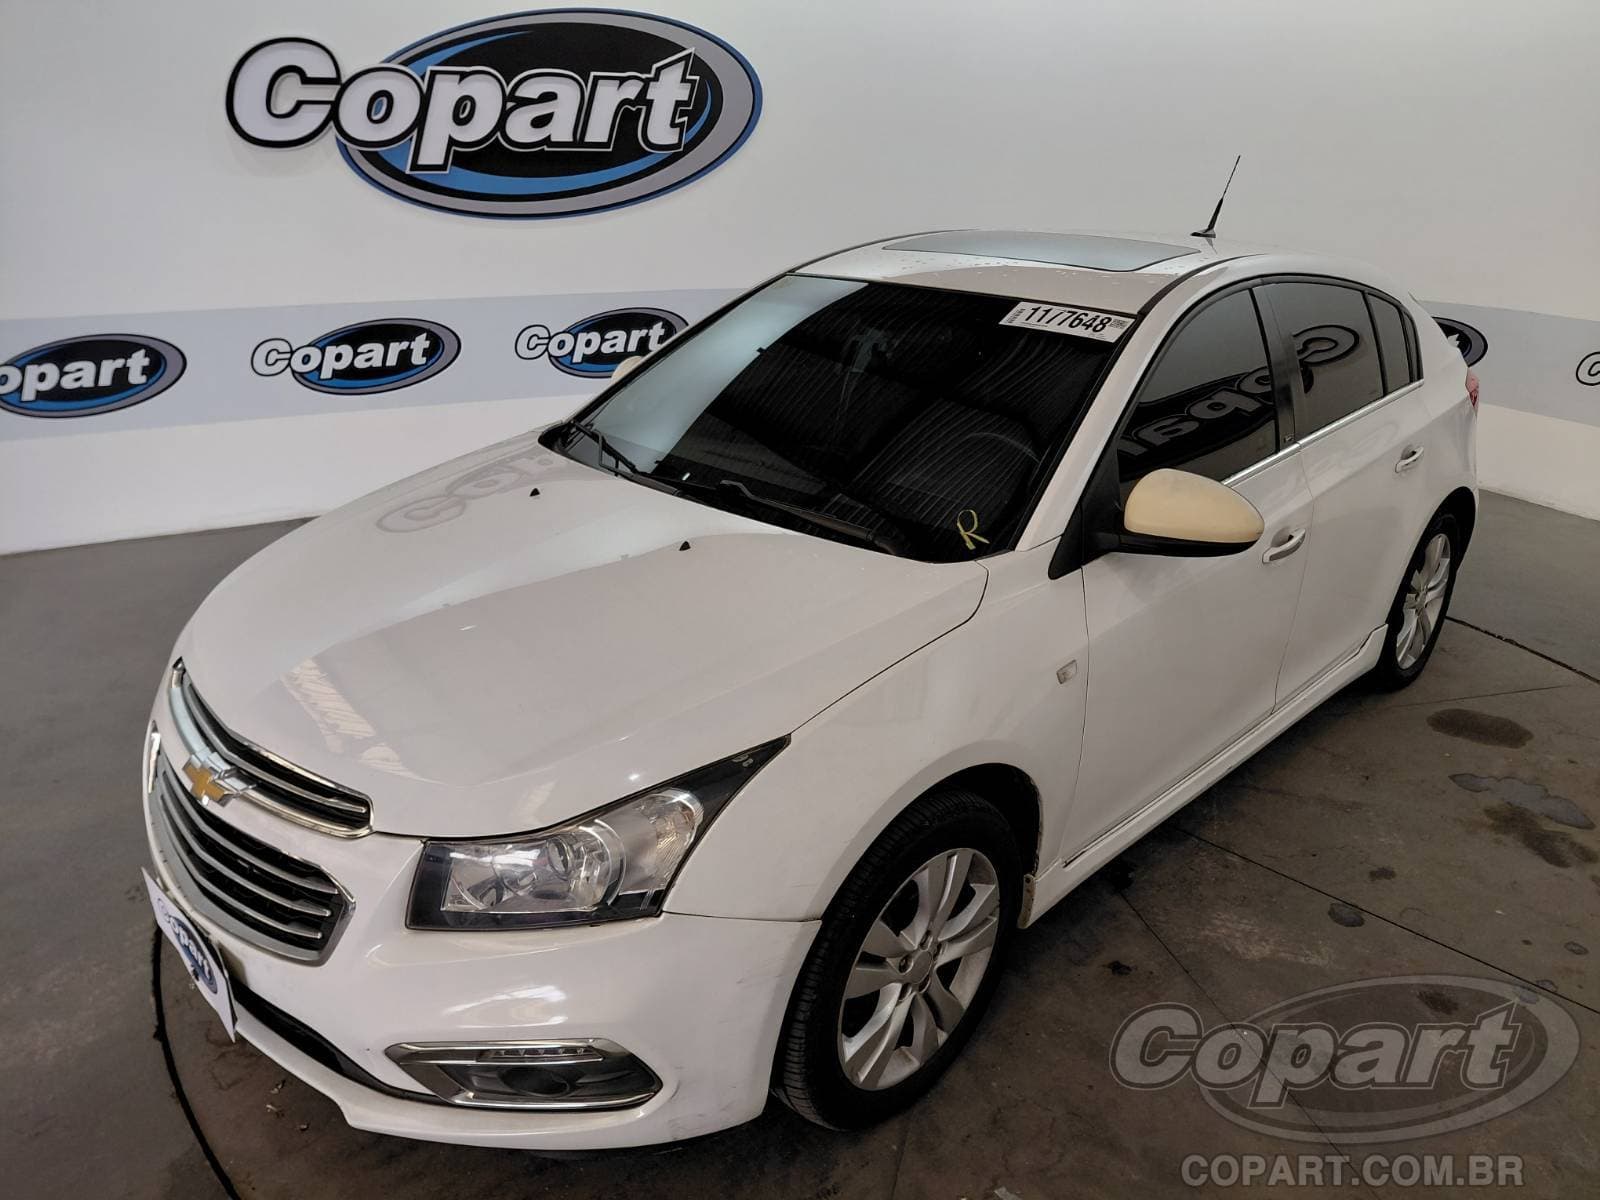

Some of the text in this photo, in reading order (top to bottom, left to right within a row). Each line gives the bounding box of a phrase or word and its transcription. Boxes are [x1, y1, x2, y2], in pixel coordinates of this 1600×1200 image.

[226, 37, 698, 173] Copart
[251, 332, 431, 380] Copart
[515, 321, 666, 365] Copart
[957, 509, 990, 550] R
